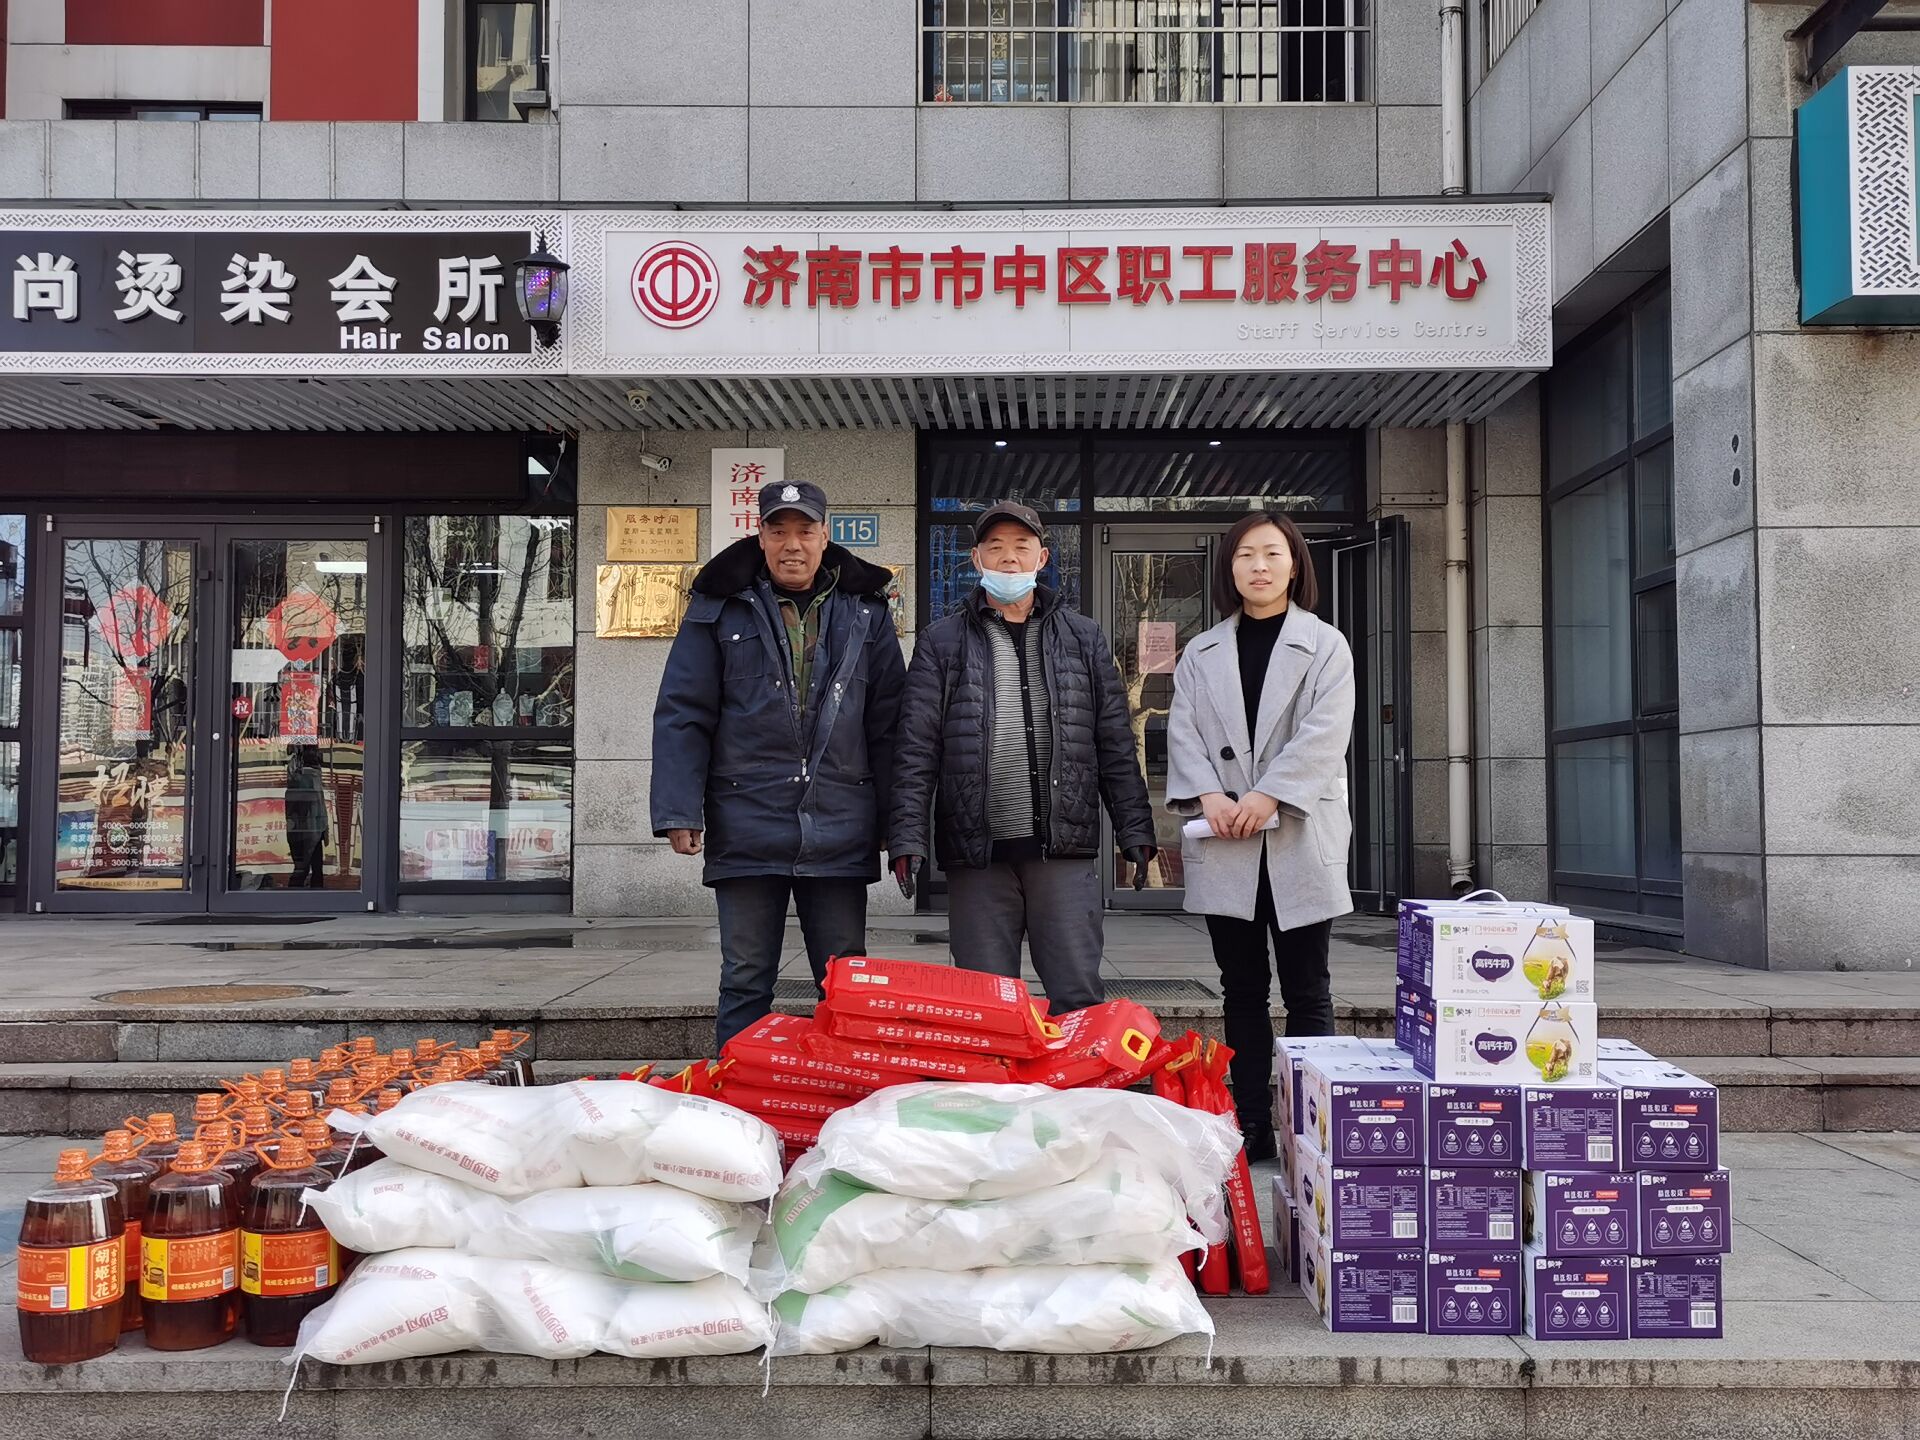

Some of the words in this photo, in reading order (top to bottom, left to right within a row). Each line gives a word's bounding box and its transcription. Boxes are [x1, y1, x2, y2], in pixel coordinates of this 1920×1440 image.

[743, 238, 1487, 309] 济南市市中区职工服务中心
[13, 252, 504, 324] 尚烫染会所
[340, 326, 402, 351] Hair
[422, 326, 510, 351] Salon
[1237, 322, 1298, 339] Staff
[1312, 321, 1400, 338] Service
[1413, 320, 1487, 337] Centre
[730, 462, 767, 541] 济南市
[625, 514, 679, 524] 服务时间
[836, 519, 872, 541] 115
[235, 700, 249, 715] 拉
[84, 762, 169, 810] 招聘
[1475, 958, 1510, 969] 高钙牛奶
[1478, 1040, 1513, 1051] 高钙牛奶
[94, 1248, 110, 1298] 胡姬花
